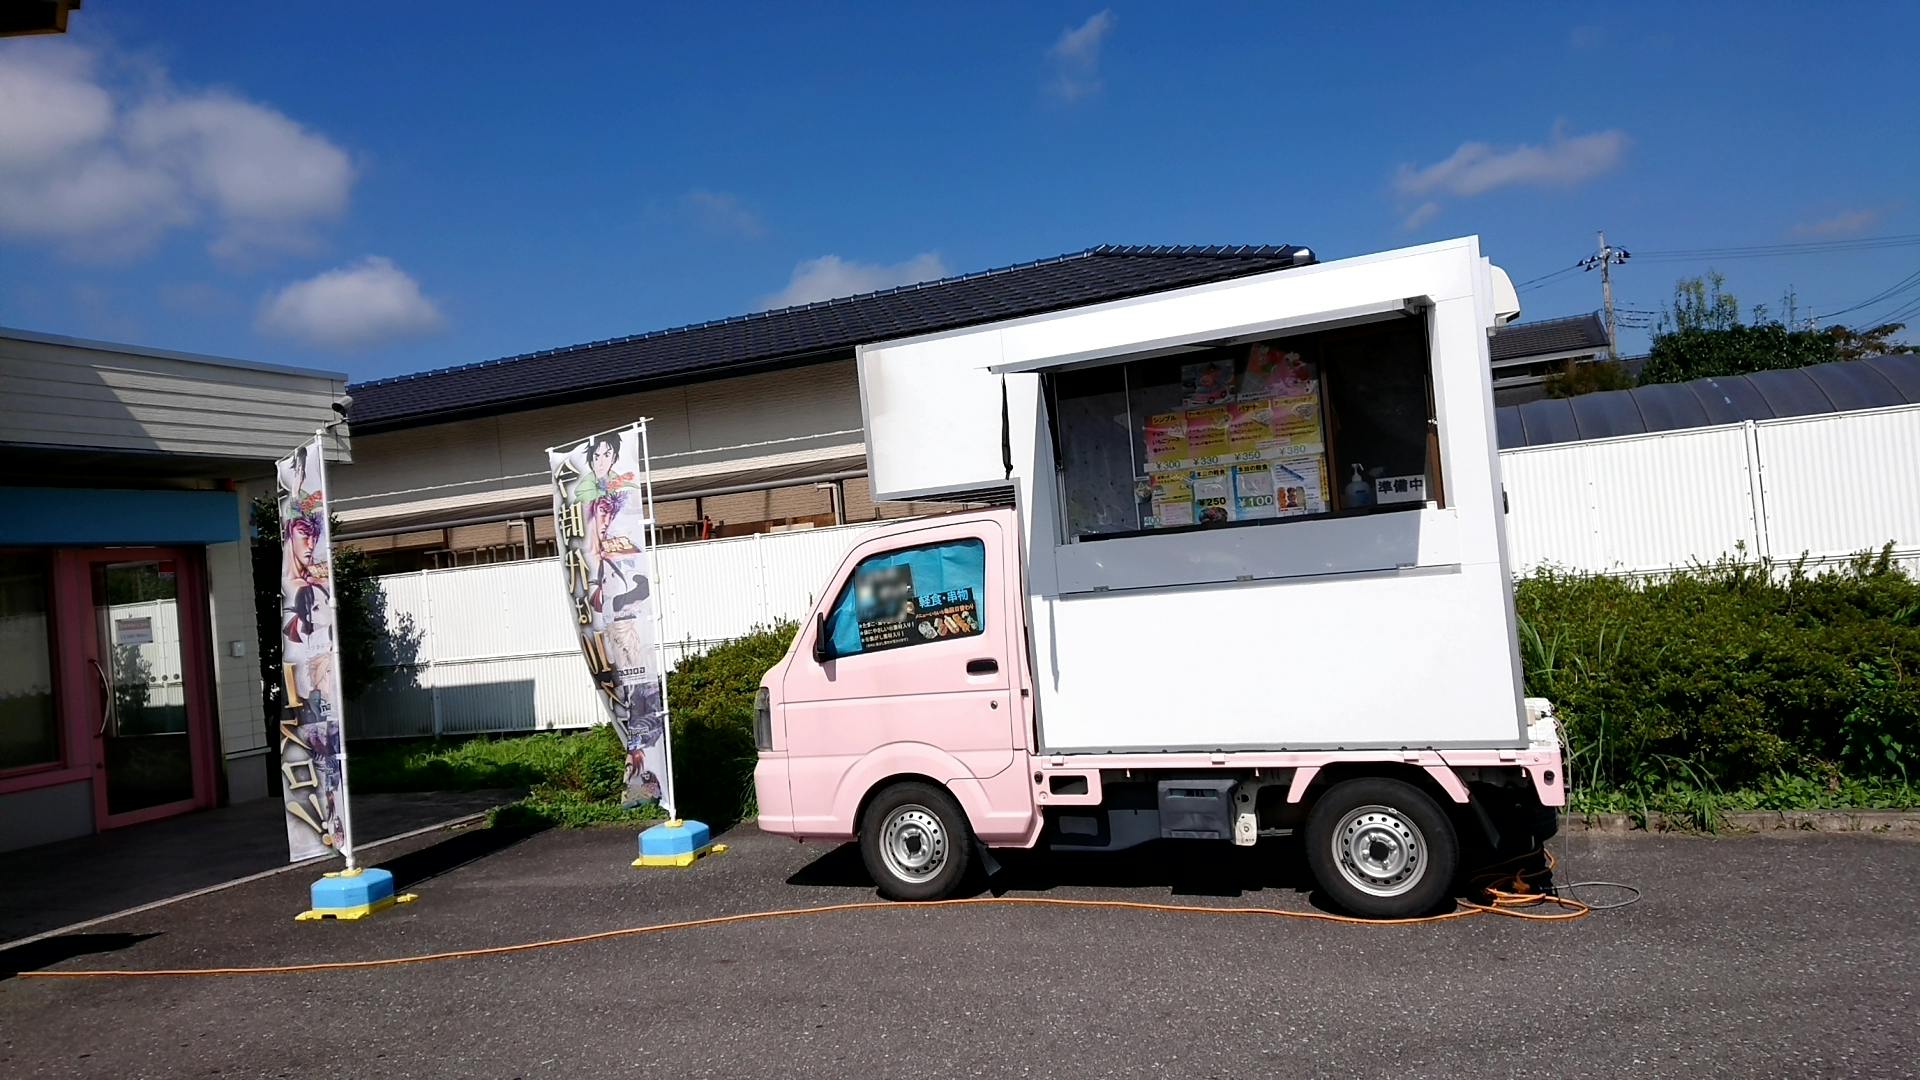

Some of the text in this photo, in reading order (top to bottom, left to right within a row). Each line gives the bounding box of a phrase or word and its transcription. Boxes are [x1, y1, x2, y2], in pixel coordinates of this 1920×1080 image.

[1193, 456, 1219, 465] ¥330
[1235, 451, 1261, 460] ¥350
[1157, 461, 1181, 470] ¥300
[1378, 477, 1423, 494] 準備中
[1199, 497, 1226, 507] ¥250
[1239, 495, 1273, 507] ¥100
[919, 590, 969, 609] 軽食・串物
